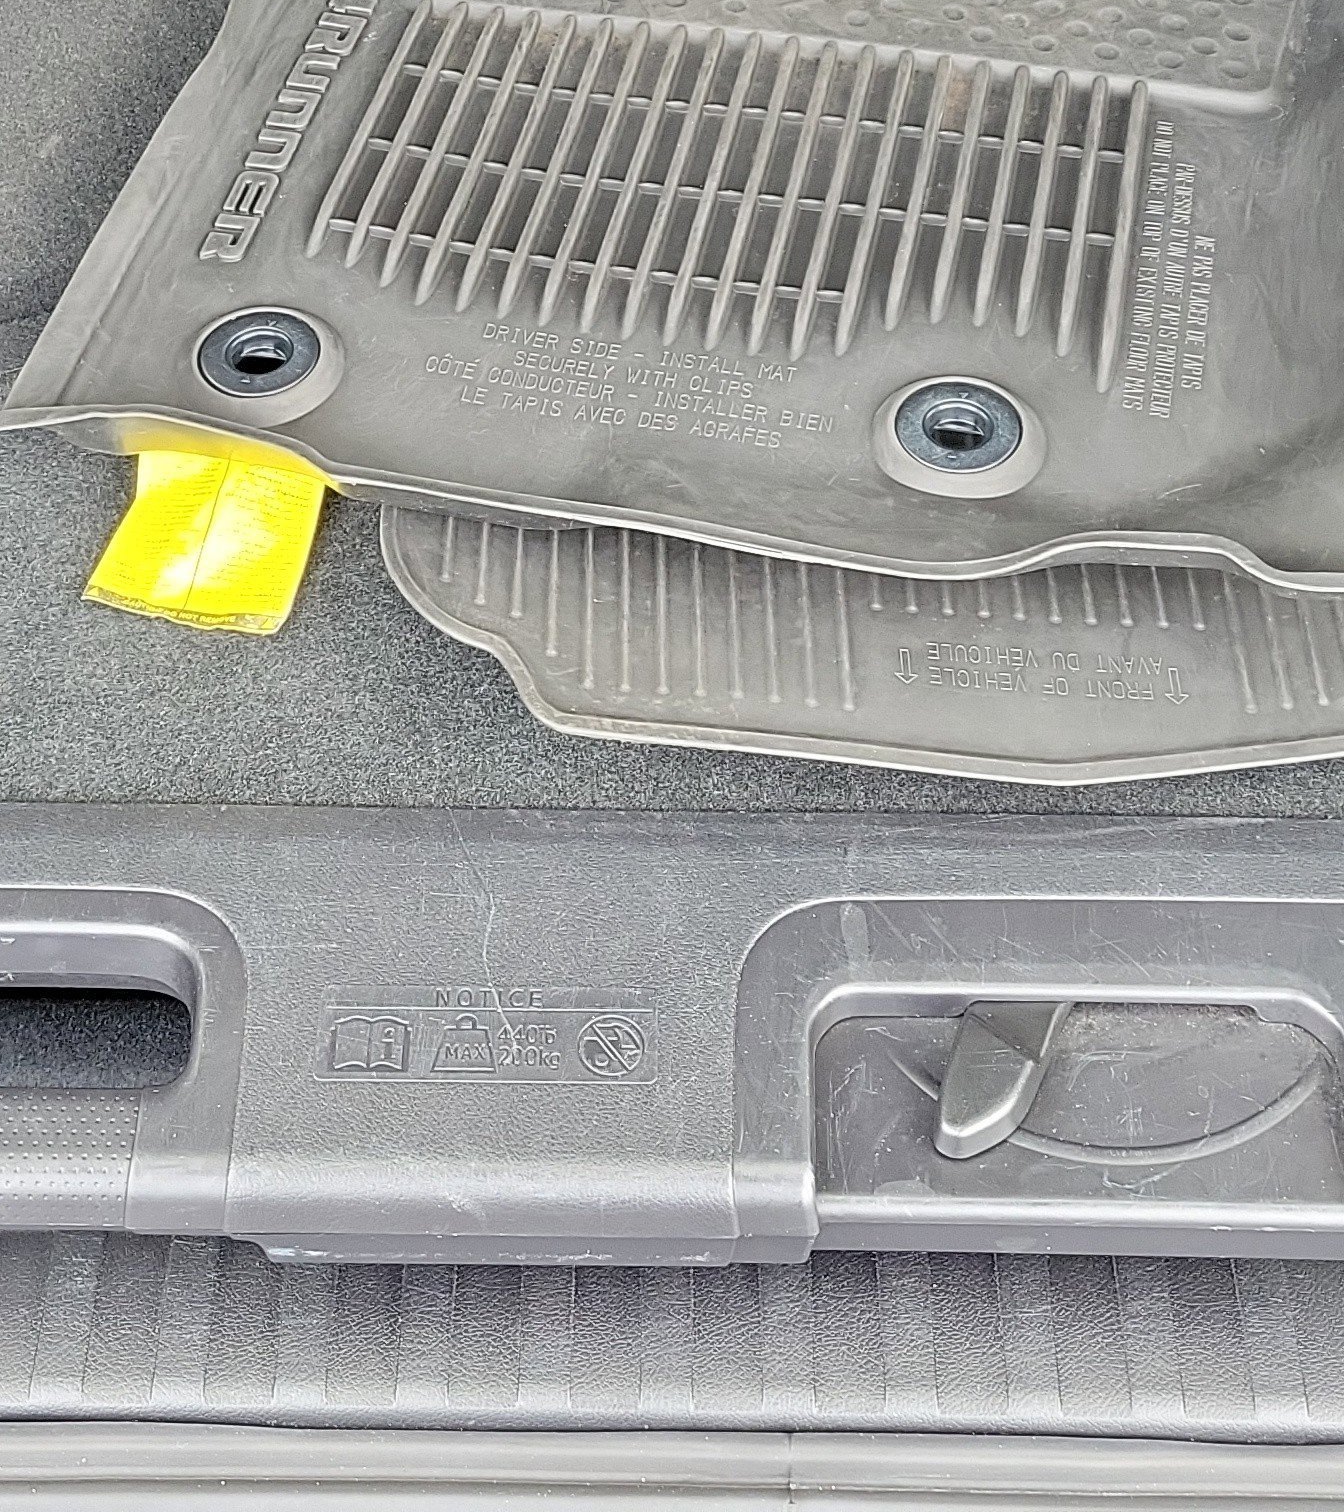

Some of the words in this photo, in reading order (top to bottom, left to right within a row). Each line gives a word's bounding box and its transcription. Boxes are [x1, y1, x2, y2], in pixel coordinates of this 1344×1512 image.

[1148, 162, 1170, 195] PLACE
[1145, 200, 1165, 217] ON
[1142, 221, 1163, 242] TOP
[1194, 235, 1216, 252] NE
[1139, 246, 1161, 264] OF
[1191, 256, 1214, 281] PAS
[1162, 262, 1186, 298] AUTRE
[1131, 266, 1158, 329] EXISTING
[1186, 282, 1212, 329] PLACER
[1157, 302, 1182, 341] TAPIS
[482, 322, 559, 350] DRIVER
[570, 338, 622, 360] SIDE
[659, 351, 745, 377] INSTALL
[758, 363, 797, 383] MAT
[1126, 332, 1151, 372] FLOOR
[1184, 330, 1206, 348] DE
[513, 351, 615, 381] SECURELY
[627, 366, 677, 389] WITH
[689, 375, 754, 400] CLIPS
[1149, 342, 1177, 419] PROTECTEUR
[1180, 353, 1205, 391] TAPIS
[425, 352, 481, 379] CÔTÉ
[488, 366, 615, 403] CONDUCTEUR
[654, 391, 768, 422] INSTALLER
[779, 411, 833, 434] BIEN
[1122, 375, 1146, 412] MATS
[460, 387, 486, 406] LE
[501, 392, 563, 418] TAPIS
[574, 405, 626, 426] AVEC
[637, 413, 679, 432] DES
[689, 421, 782, 448] AGRAFES
[1053, 652, 1080, 671] DU
[1096, 655, 1163, 675] AVANT
[929, 665, 1027, 692] VEHICLE
[1043, 677, 1070, 696] OF
[1085, 678, 1154, 700] FRONT
[435, 988, 545, 1009] NOTICE
[444, 1043, 486, 1061] MAX
